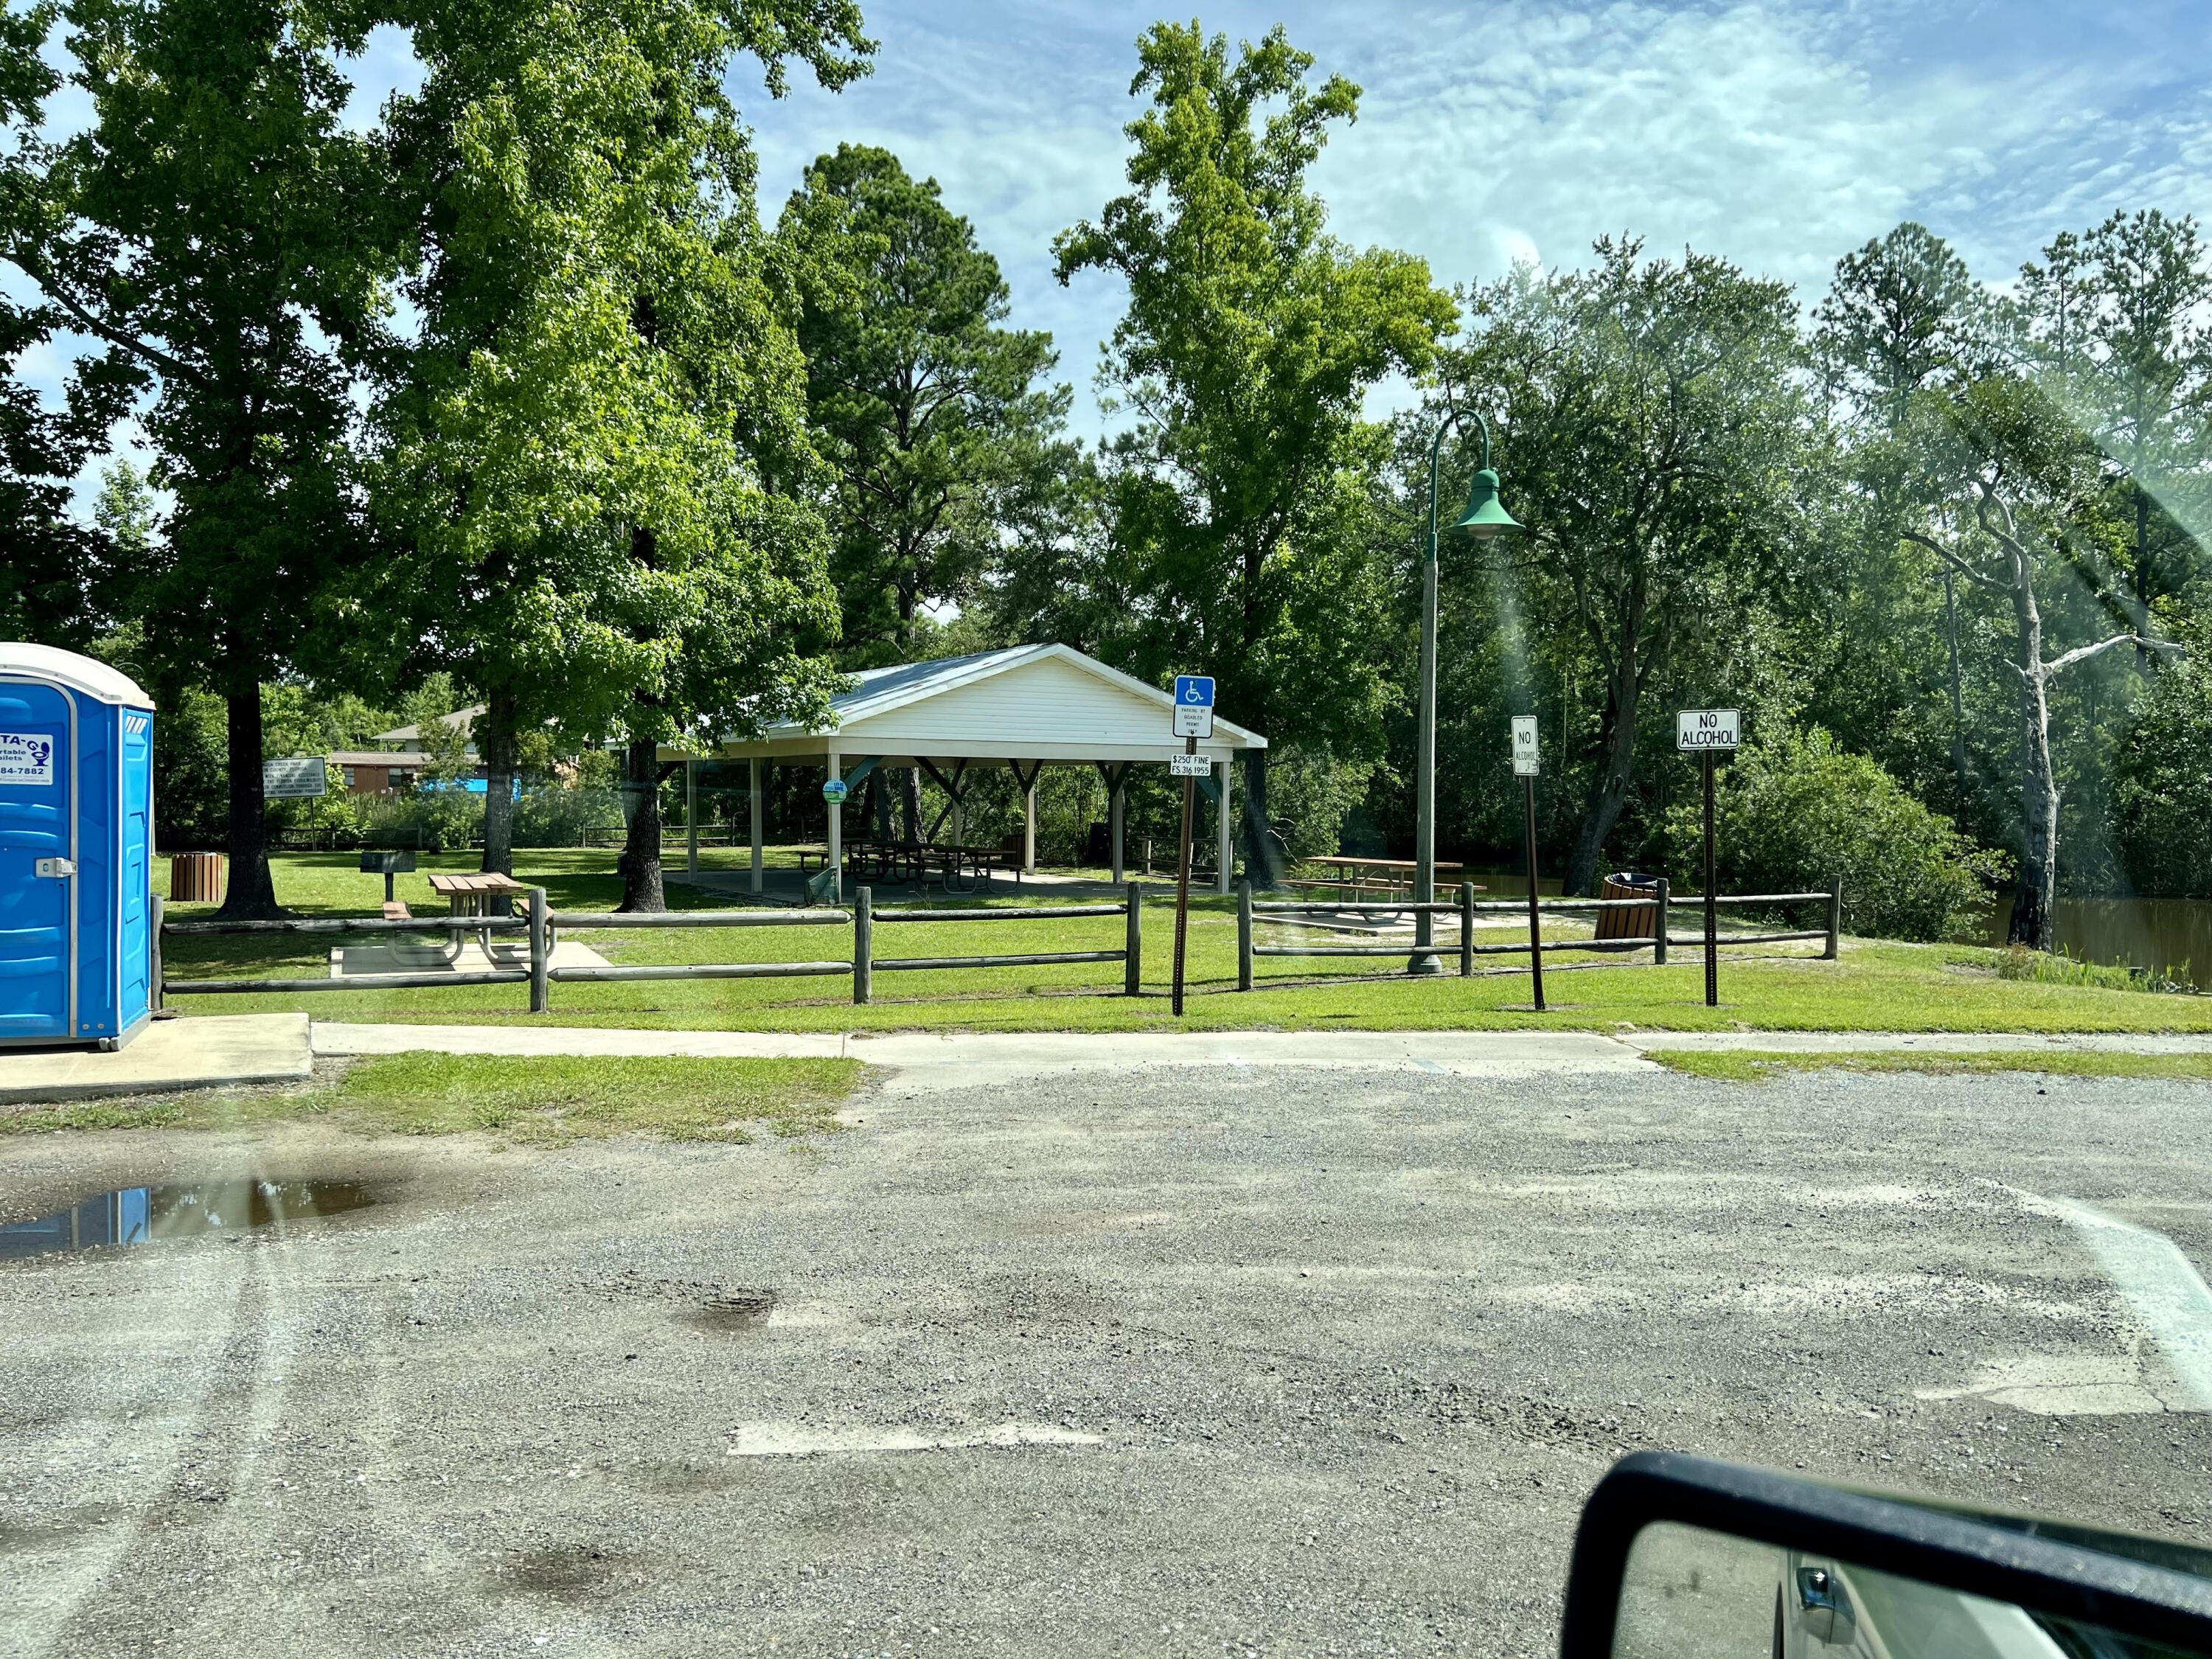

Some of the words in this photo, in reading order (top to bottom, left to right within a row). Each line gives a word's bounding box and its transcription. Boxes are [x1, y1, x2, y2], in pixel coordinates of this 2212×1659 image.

[1700, 714, 1717, 728] NO
[1519, 731, 1531, 744] NO
[1681, 730, 1737, 745] ALCOHOL
[1172, 755, 1191, 764] $250
[1194, 757, 1210, 765] FINE
[1516, 751, 1535, 760] ALCOHOL
[1172, 766, 1180, 774] FS
[1182, 766, 1192, 774] 316
[1194, 767, 1209, 775] 1955
